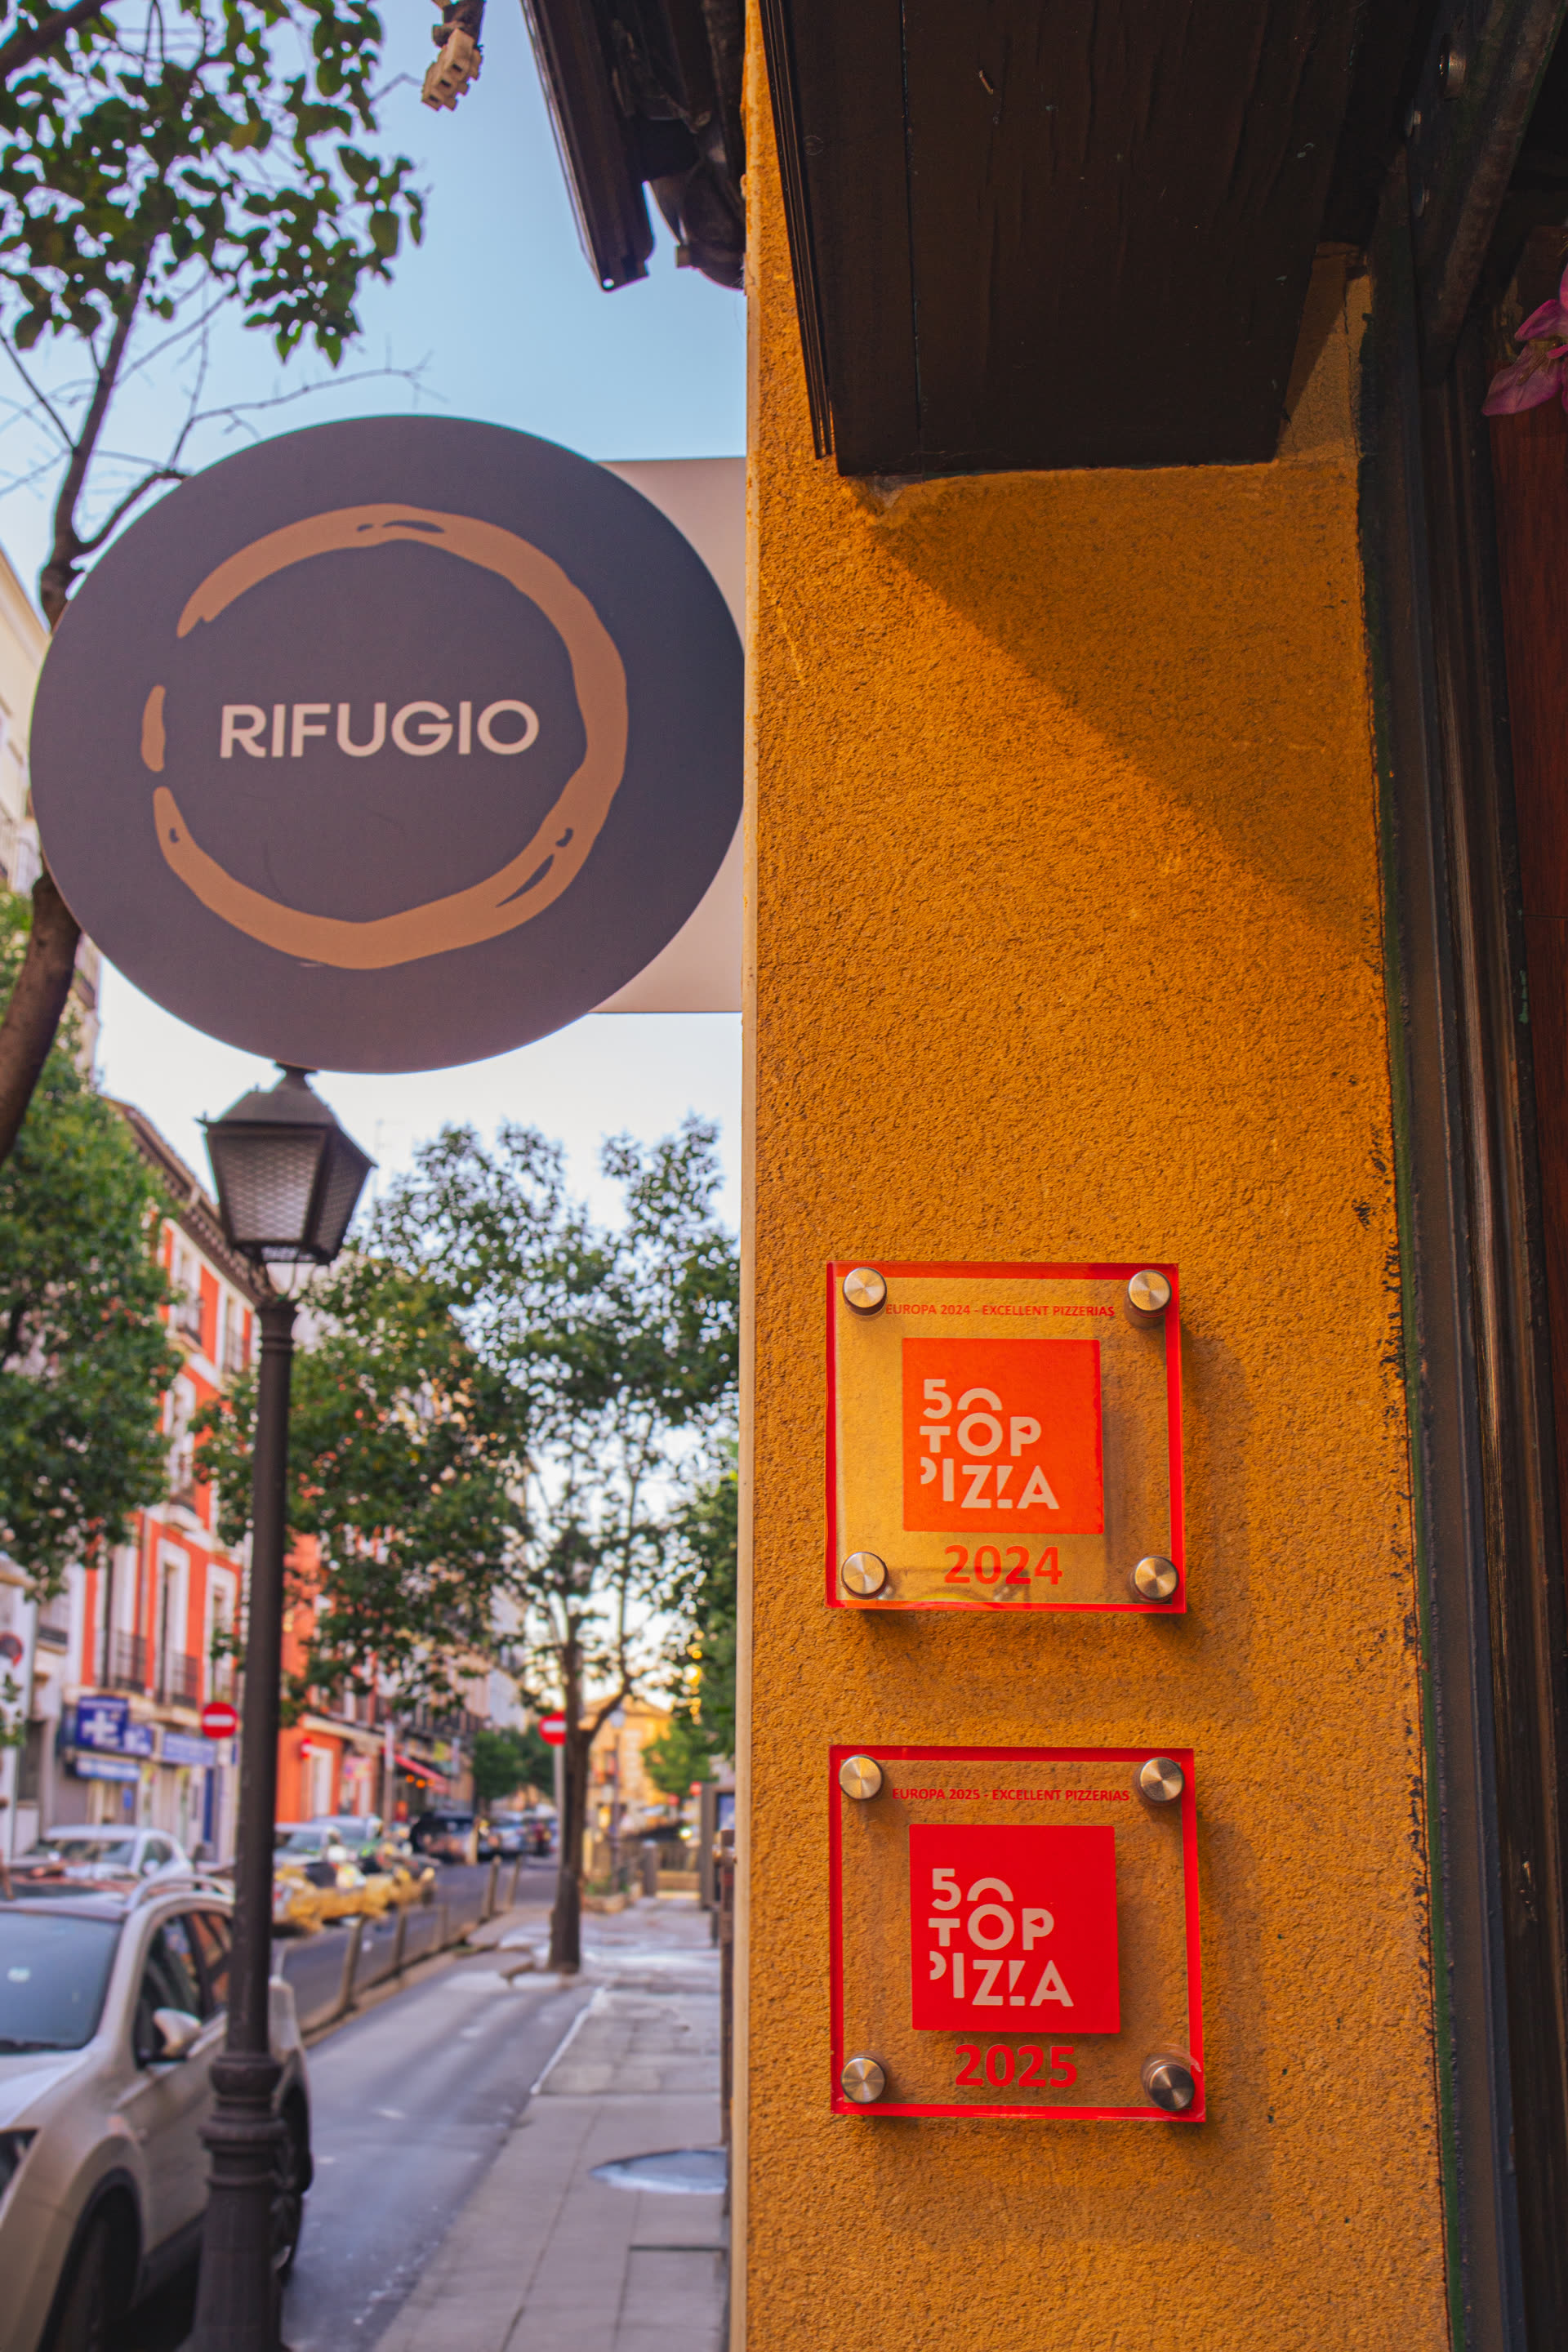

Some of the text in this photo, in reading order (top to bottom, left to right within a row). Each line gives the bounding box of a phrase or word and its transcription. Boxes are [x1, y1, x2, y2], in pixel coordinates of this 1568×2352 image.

[220, 699, 540, 758] RIFUGIO
[885, 1304, 937, 1315] EUROPA
[940, 1304, 971, 1315] 2024
[982, 1305, 1049, 1316] EXCELLENT
[1053, 1306, 1115, 1317] PIZZERIAS
[923, 1379, 1003, 1420] 50
[920, 1412, 1042, 1457] TOP
[920, 1457, 1060, 1510] PIZZA
[944, 1544, 1062, 1585] 2024
[892, 1788, 946, 1800] EUROPA
[949, 1788, 980, 1801] 2025
[992, 1789, 1062, 1801] EXCELLENT
[1065, 1789, 1129, 1802] PIZZERIAS
[931, 1868, 1014, 1911] 50
[928, 1904, 1055, 1951] TOP
[929, 1950, 1075, 2007] PIZZA
[955, 2044, 1078, 2088] 2025
